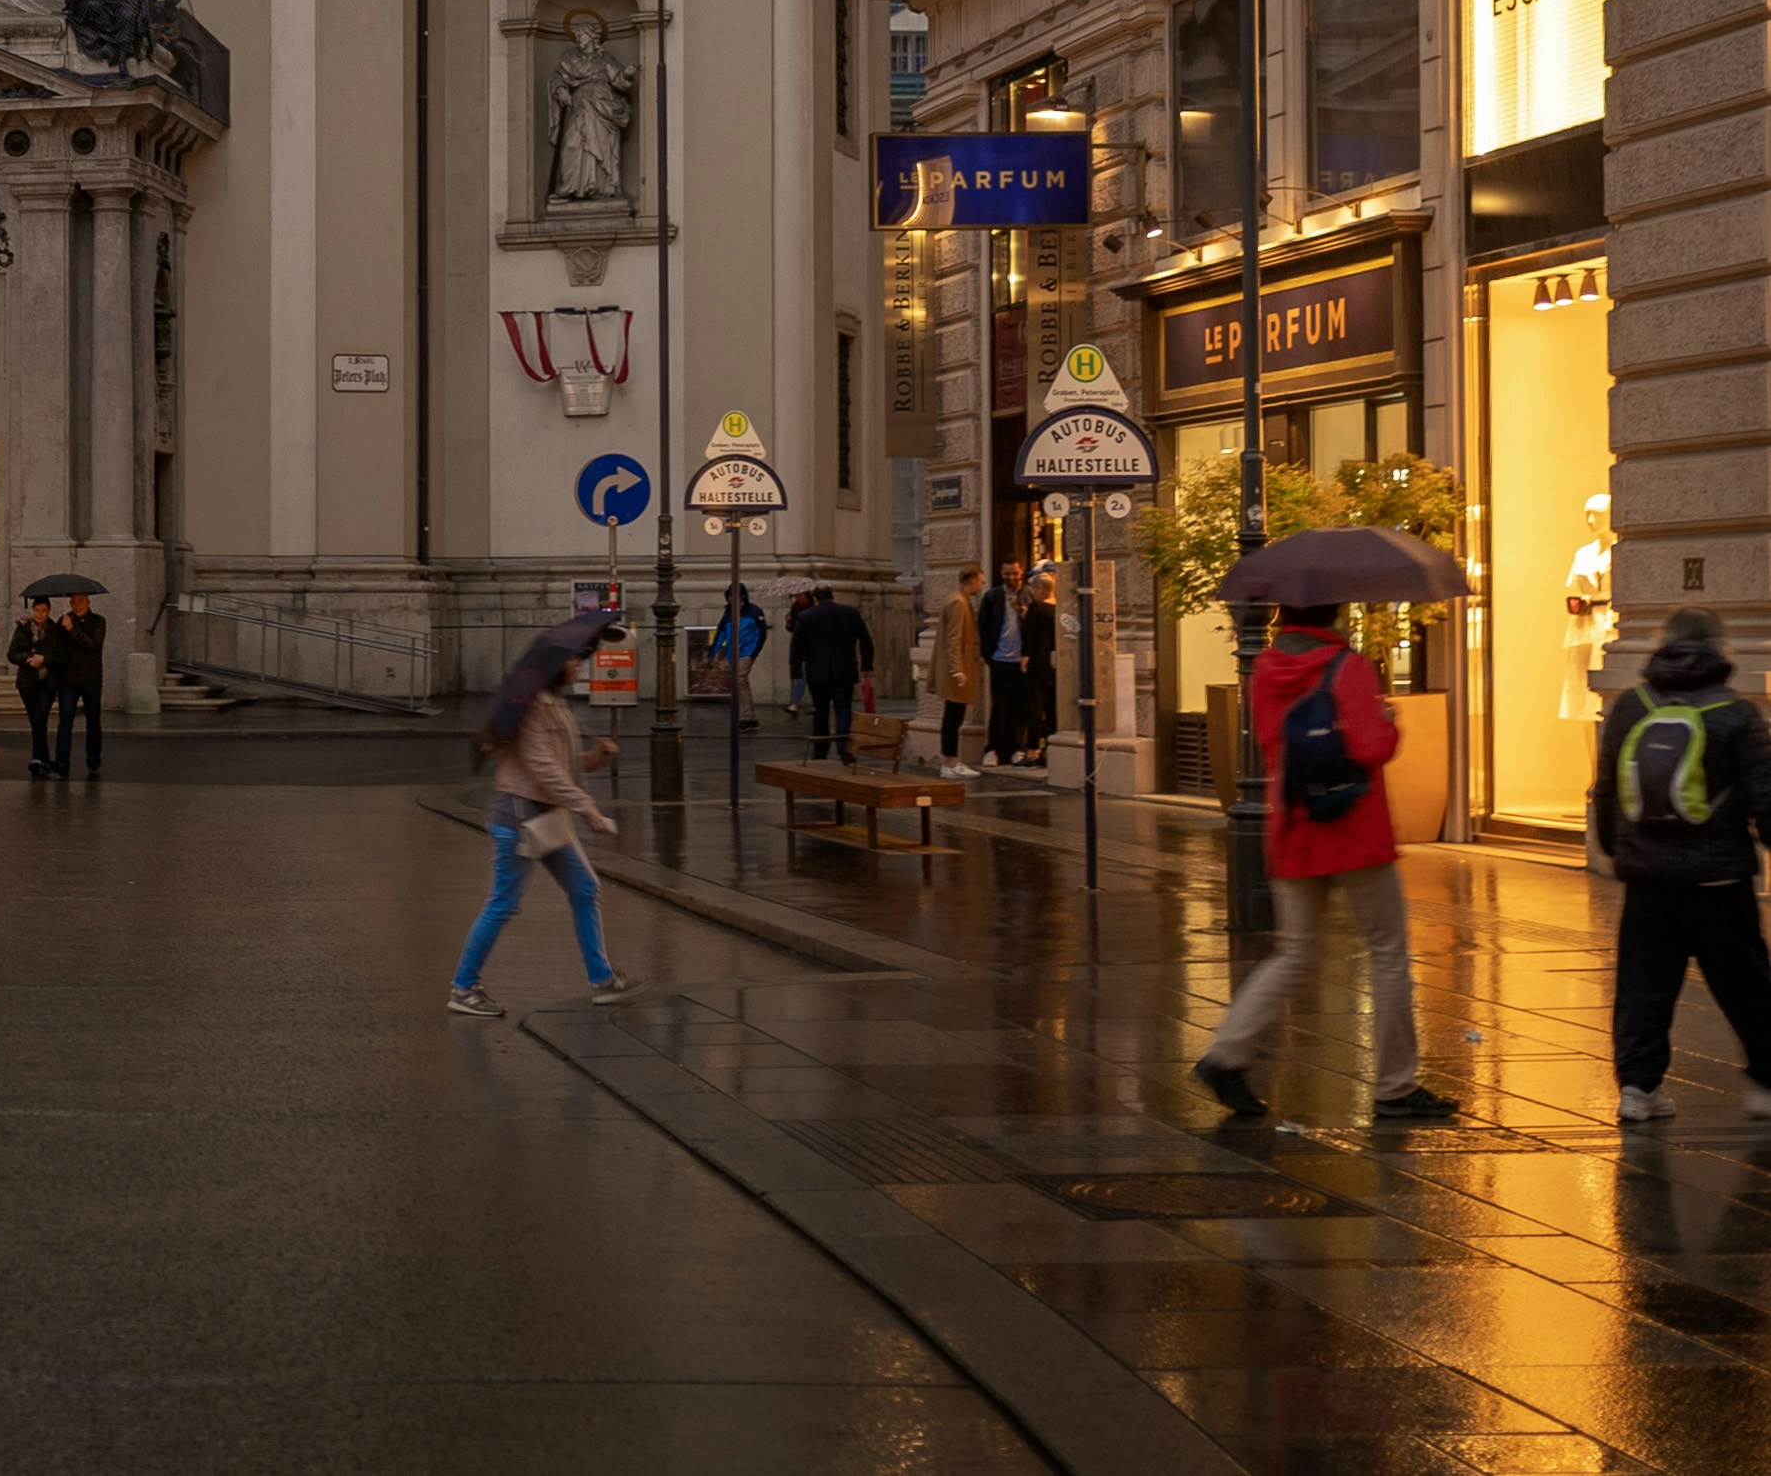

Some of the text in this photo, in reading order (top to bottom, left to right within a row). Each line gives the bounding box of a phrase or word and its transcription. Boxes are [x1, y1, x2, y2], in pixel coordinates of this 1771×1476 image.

[930, 170, 1065, 190] PARFUM
[1040, 277, 1058, 293] &
[893, 230, 912, 414] ROBBE & BERKIN
[1204, 297, 1346, 360] LE PRFUM
[1038, 301, 1058, 385] ROBBE
[1077, 353, 1094, 375] H
[729, 416, 742, 433] H
[1051, 418, 1127, 444] AUTOBUS
[709, 463, 765, 482] AUTOBUS
[1036, 458, 1140, 473] HALTESTELLE
[699, 492, 774, 502] HALTESTELLE
